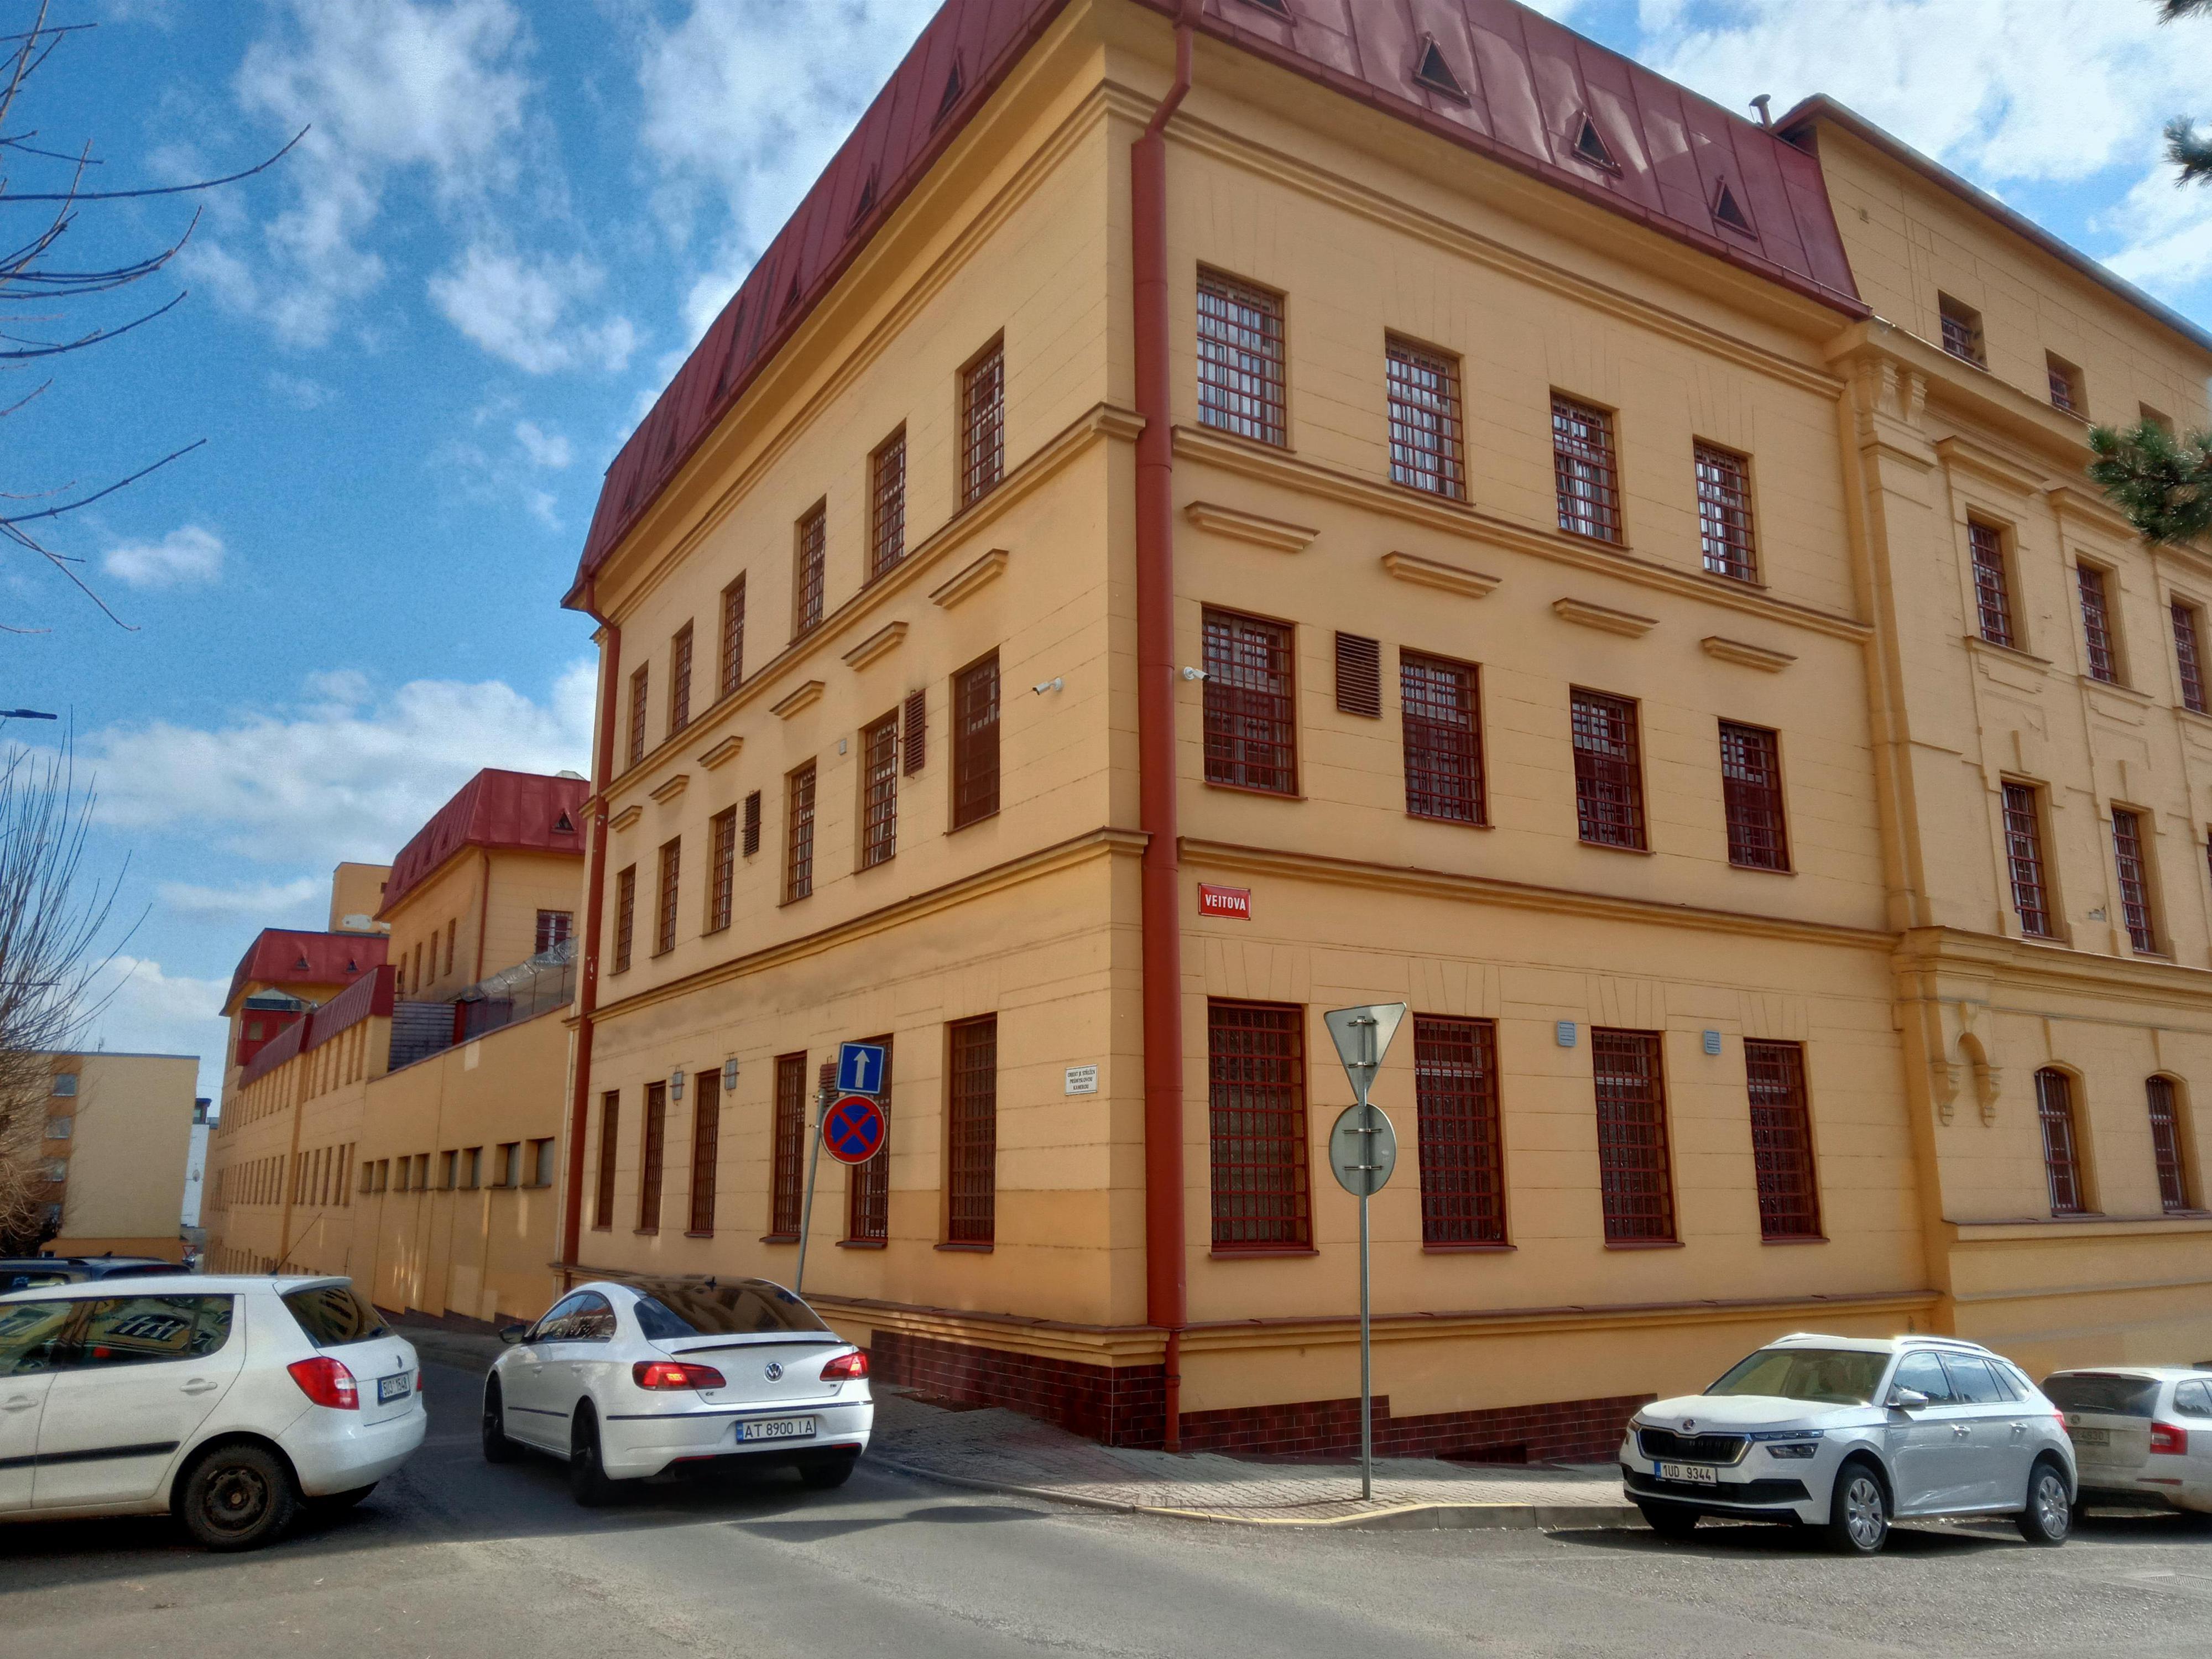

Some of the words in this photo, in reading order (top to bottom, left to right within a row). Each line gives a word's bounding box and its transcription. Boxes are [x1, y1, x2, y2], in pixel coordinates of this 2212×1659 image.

[1205, 894, 1246, 910] VEITOVA
[745, 1424, 763, 1438] AT
[766, 1422, 794, 1436] 8900
[1663, 1465, 1680, 1478] 1UD
[1687, 1467, 1712, 1481] 9344
